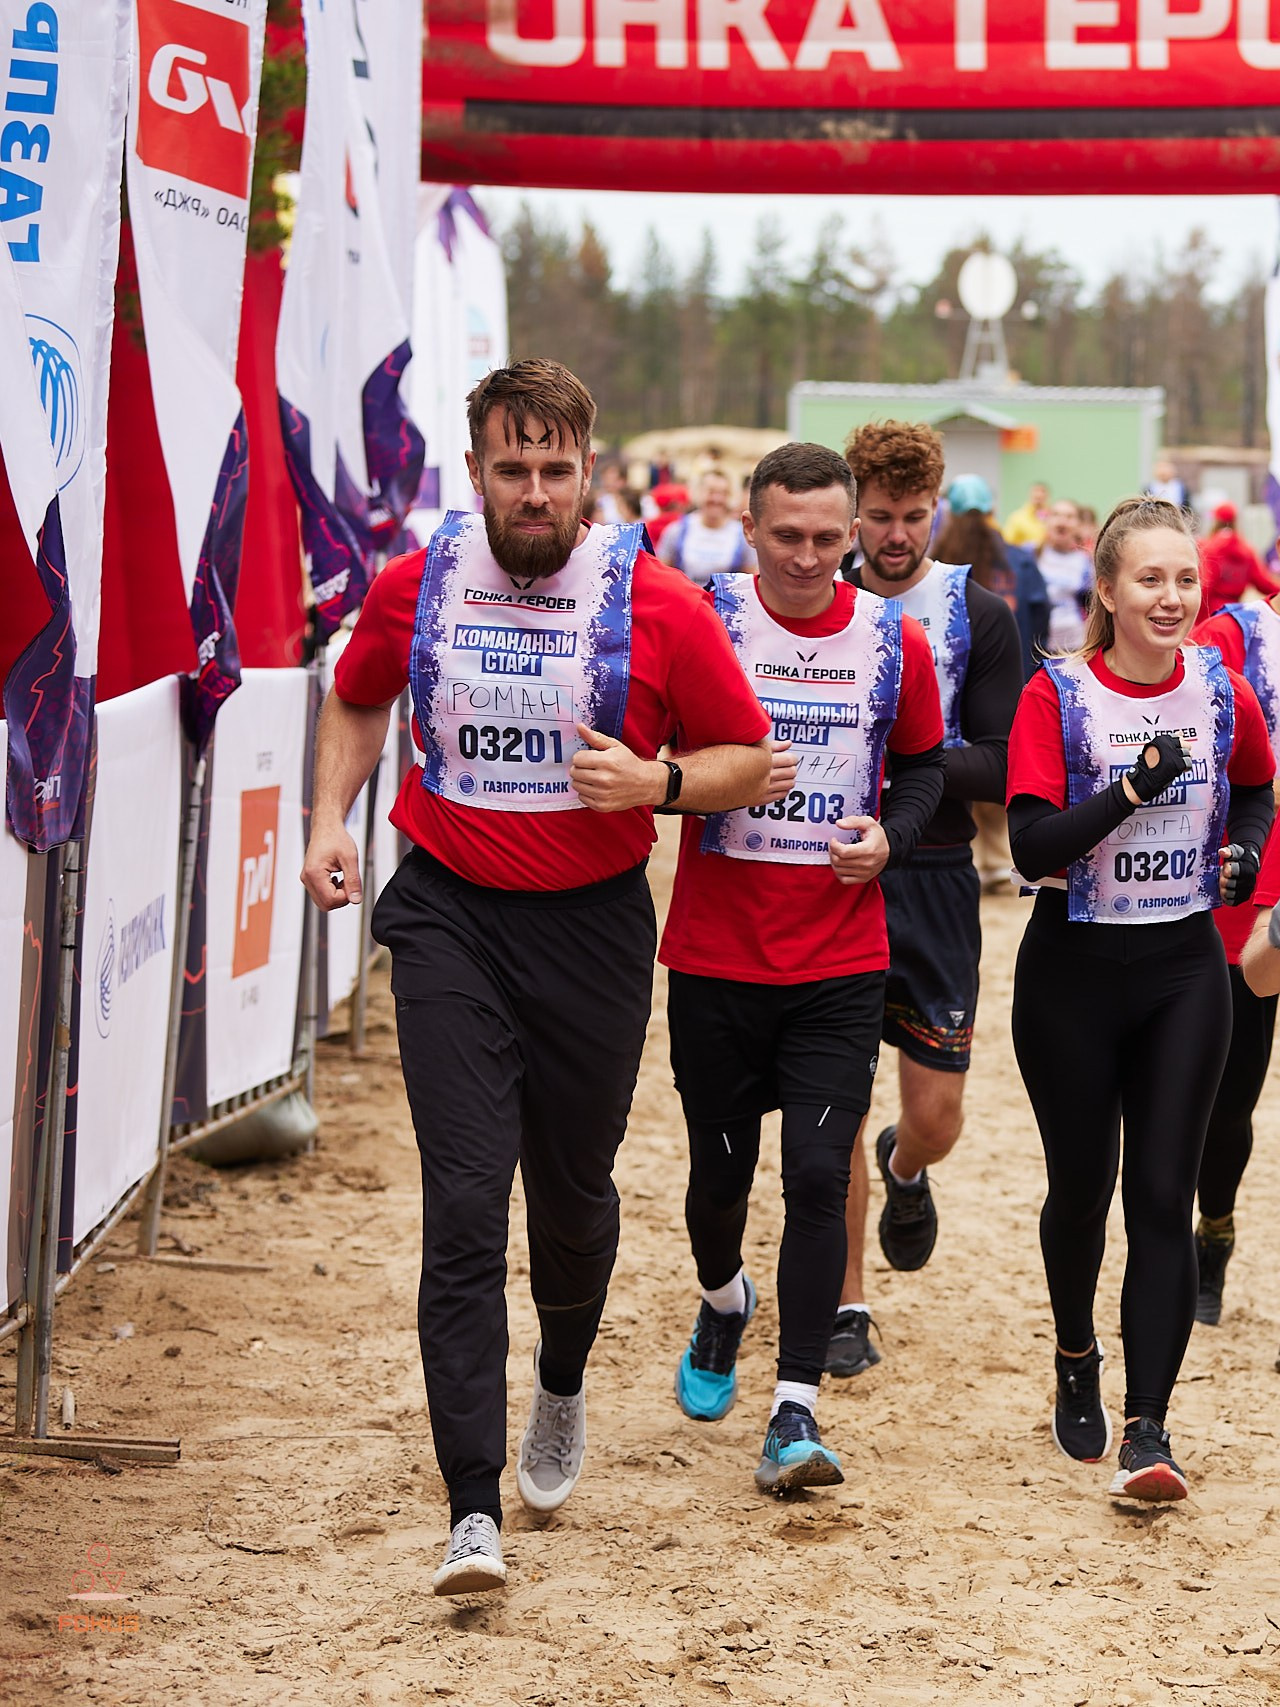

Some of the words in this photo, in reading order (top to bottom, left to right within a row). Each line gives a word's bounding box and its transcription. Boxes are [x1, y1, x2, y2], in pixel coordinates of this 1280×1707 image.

[464, 588, 513, 604] ГОНКА
[516, 592, 577, 611] ГЕРОЕВ
[455, 627, 575, 655] КОМАНДНЫЙ
[485, 650, 540, 674] СТАРТ
[755, 663, 800, 678] ГОНКА
[804, 667, 856, 680] ГЕРОЕВ
[452, 682, 560, 719] РОМАН
[760, 700, 857, 725] ОМАНДНЫЙ
[458, 723, 563, 764] 03201
[777, 722, 826, 743] СТАРТ
[1109, 732, 1151, 743] ГОНКА
[483, 780, 570, 794] ГАЗПРОМБАНК
[1117, 814, 1191, 840] ОЛЬГА
[770, 837, 829, 852] ГАЗПРОМБА
[1114, 848, 1197, 882] 03202
